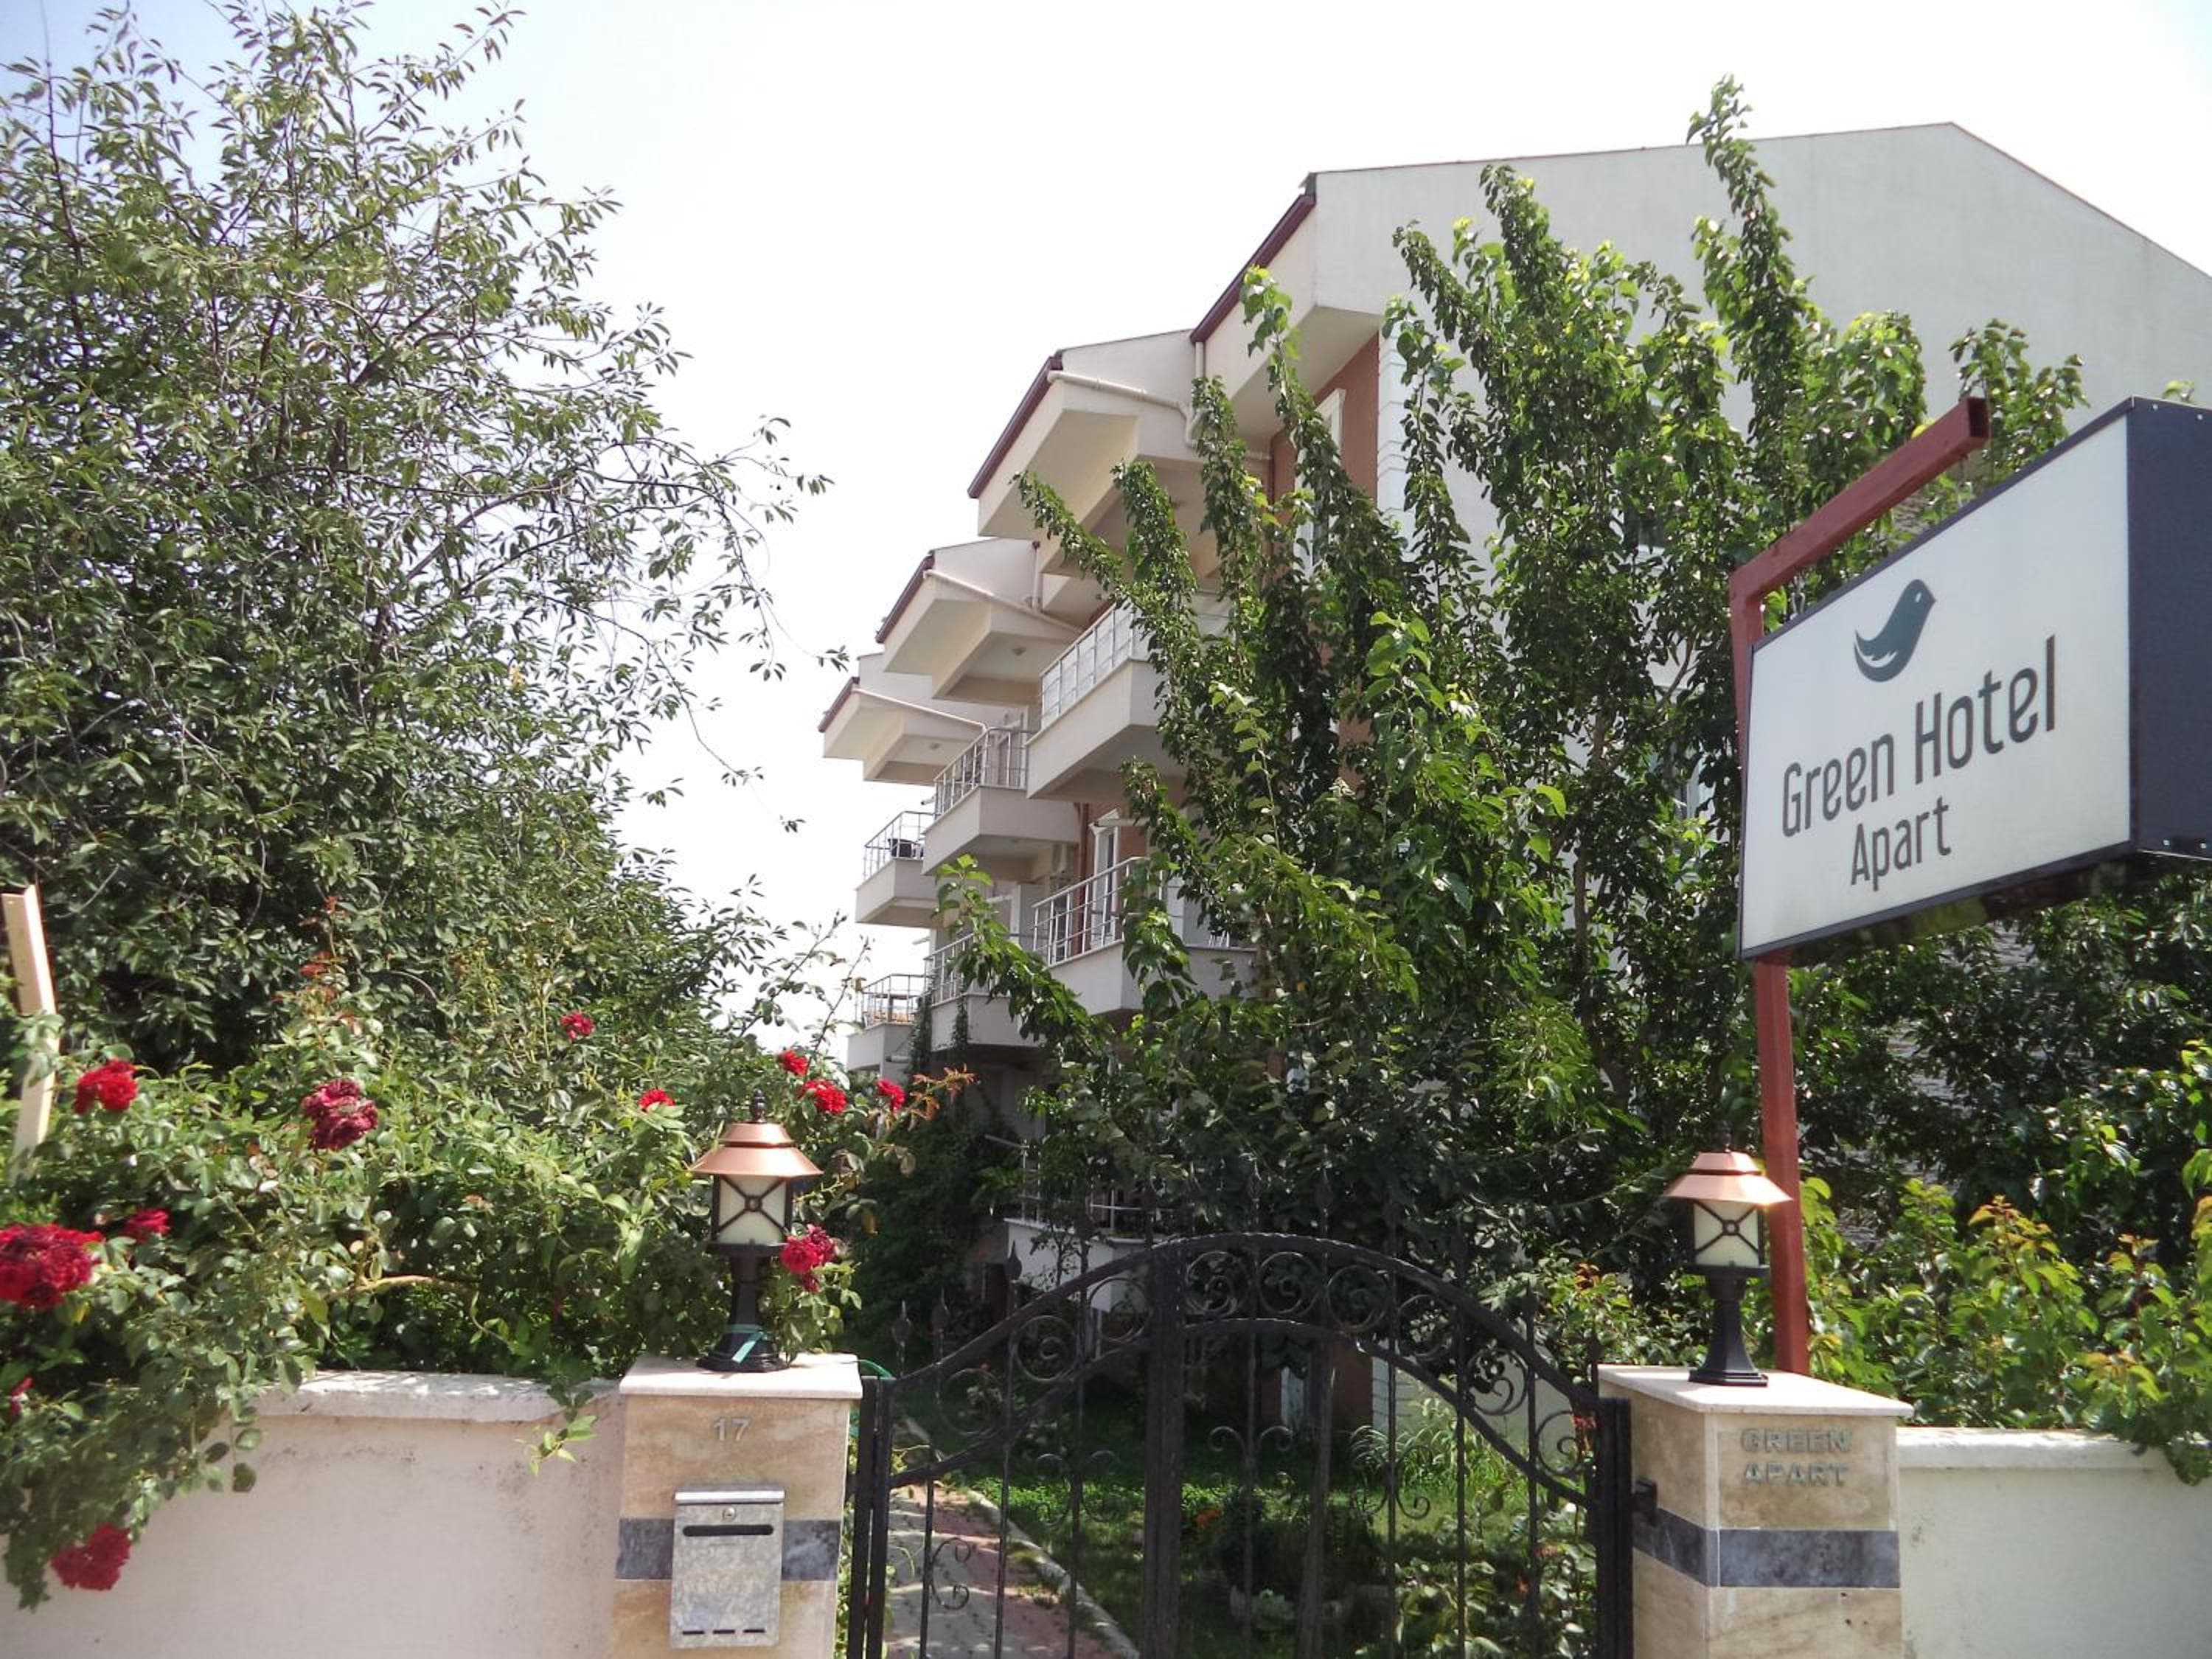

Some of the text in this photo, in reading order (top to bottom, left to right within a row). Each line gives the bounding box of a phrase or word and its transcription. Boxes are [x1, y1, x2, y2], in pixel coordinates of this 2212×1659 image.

[1782, 635, 2055, 838] Green Hotel
[1851, 796, 1951, 891] Apart
[713, 1416, 750, 1441] 17
[1740, 1428, 1852, 1453] GREEN
[1745, 1461, 1848, 1487] APART
